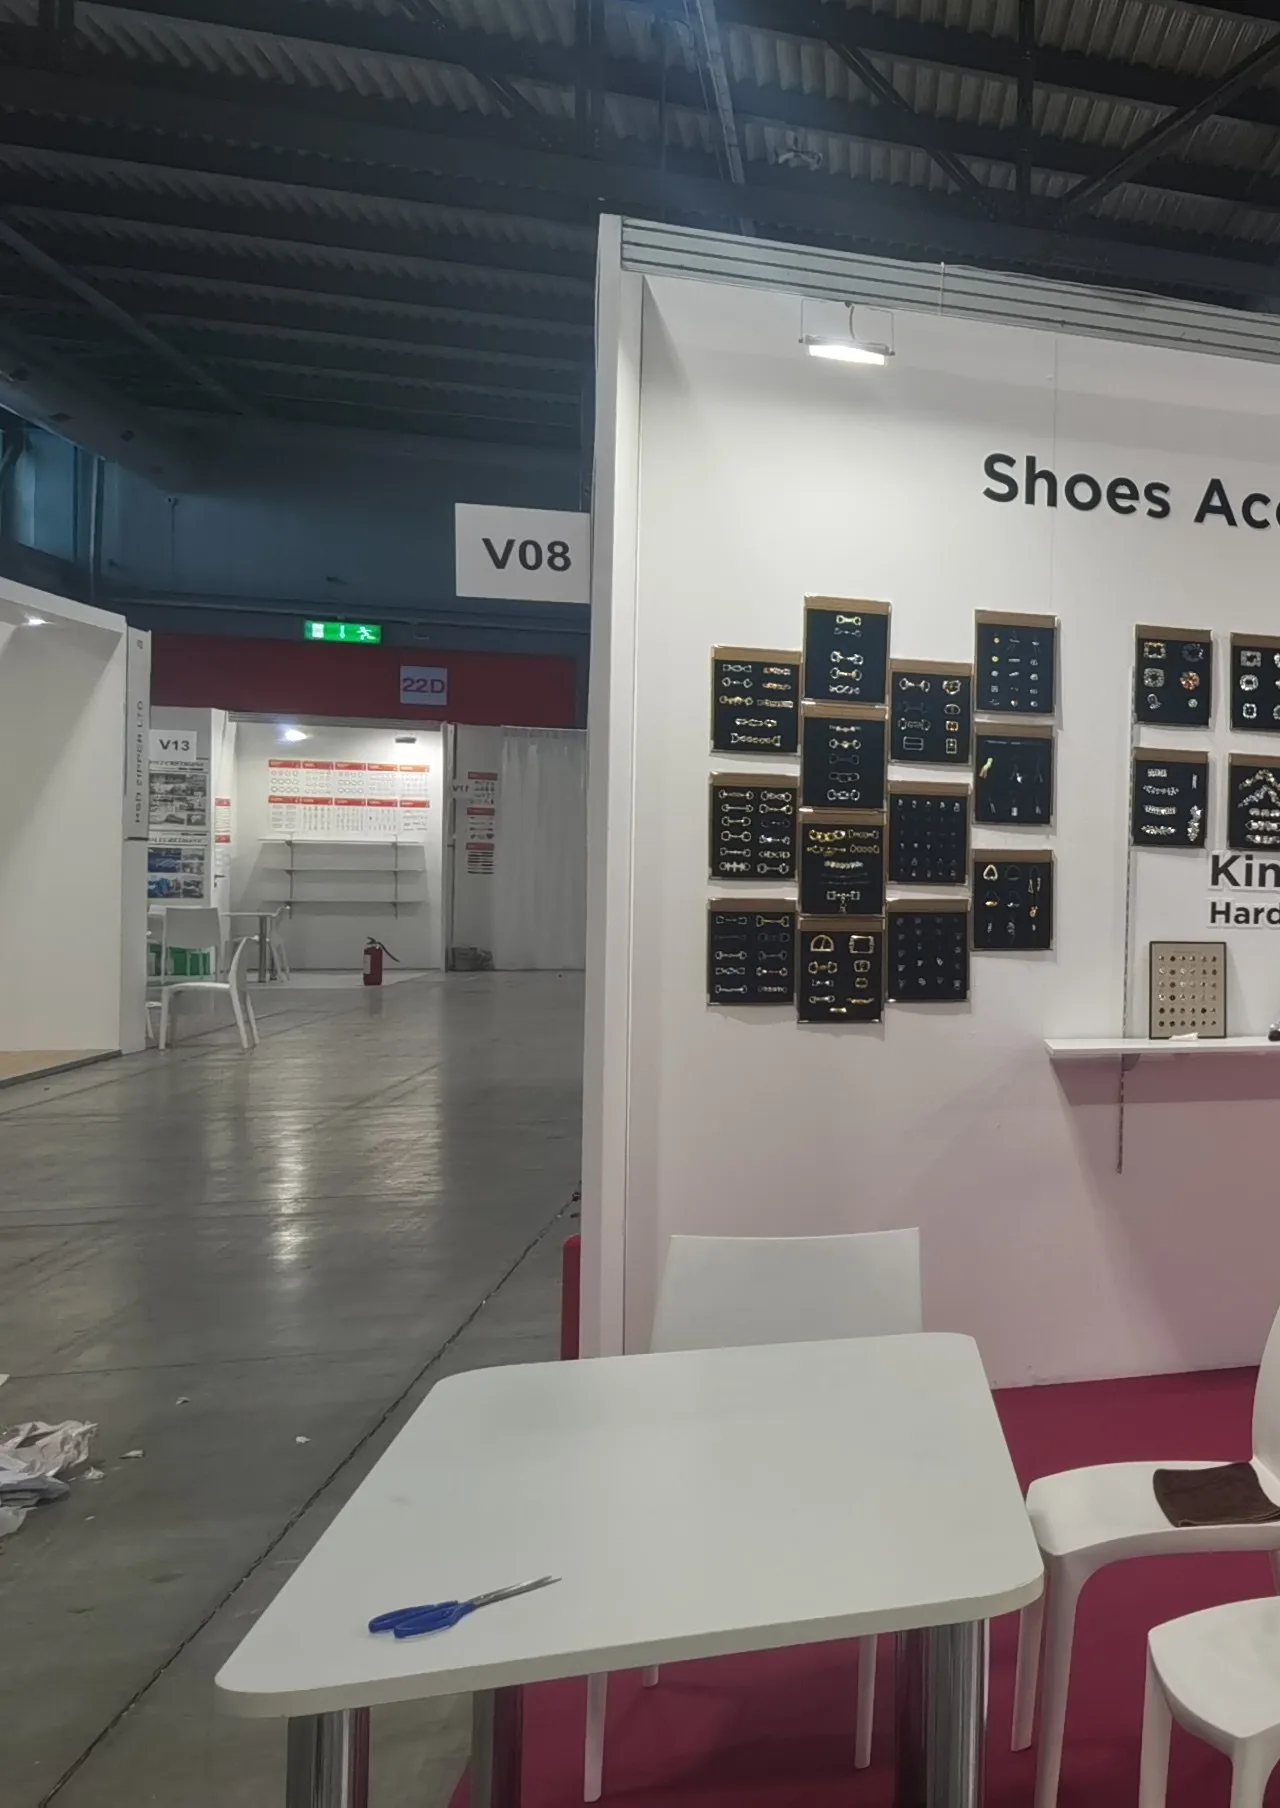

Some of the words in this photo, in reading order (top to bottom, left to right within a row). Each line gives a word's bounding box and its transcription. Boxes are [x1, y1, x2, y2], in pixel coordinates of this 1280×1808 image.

[982, 452, 1172, 519] Shoes
[481, 537, 573, 572] V08
[402, 677, 446, 694] 22D
[158, 738, 191, 752] V13
